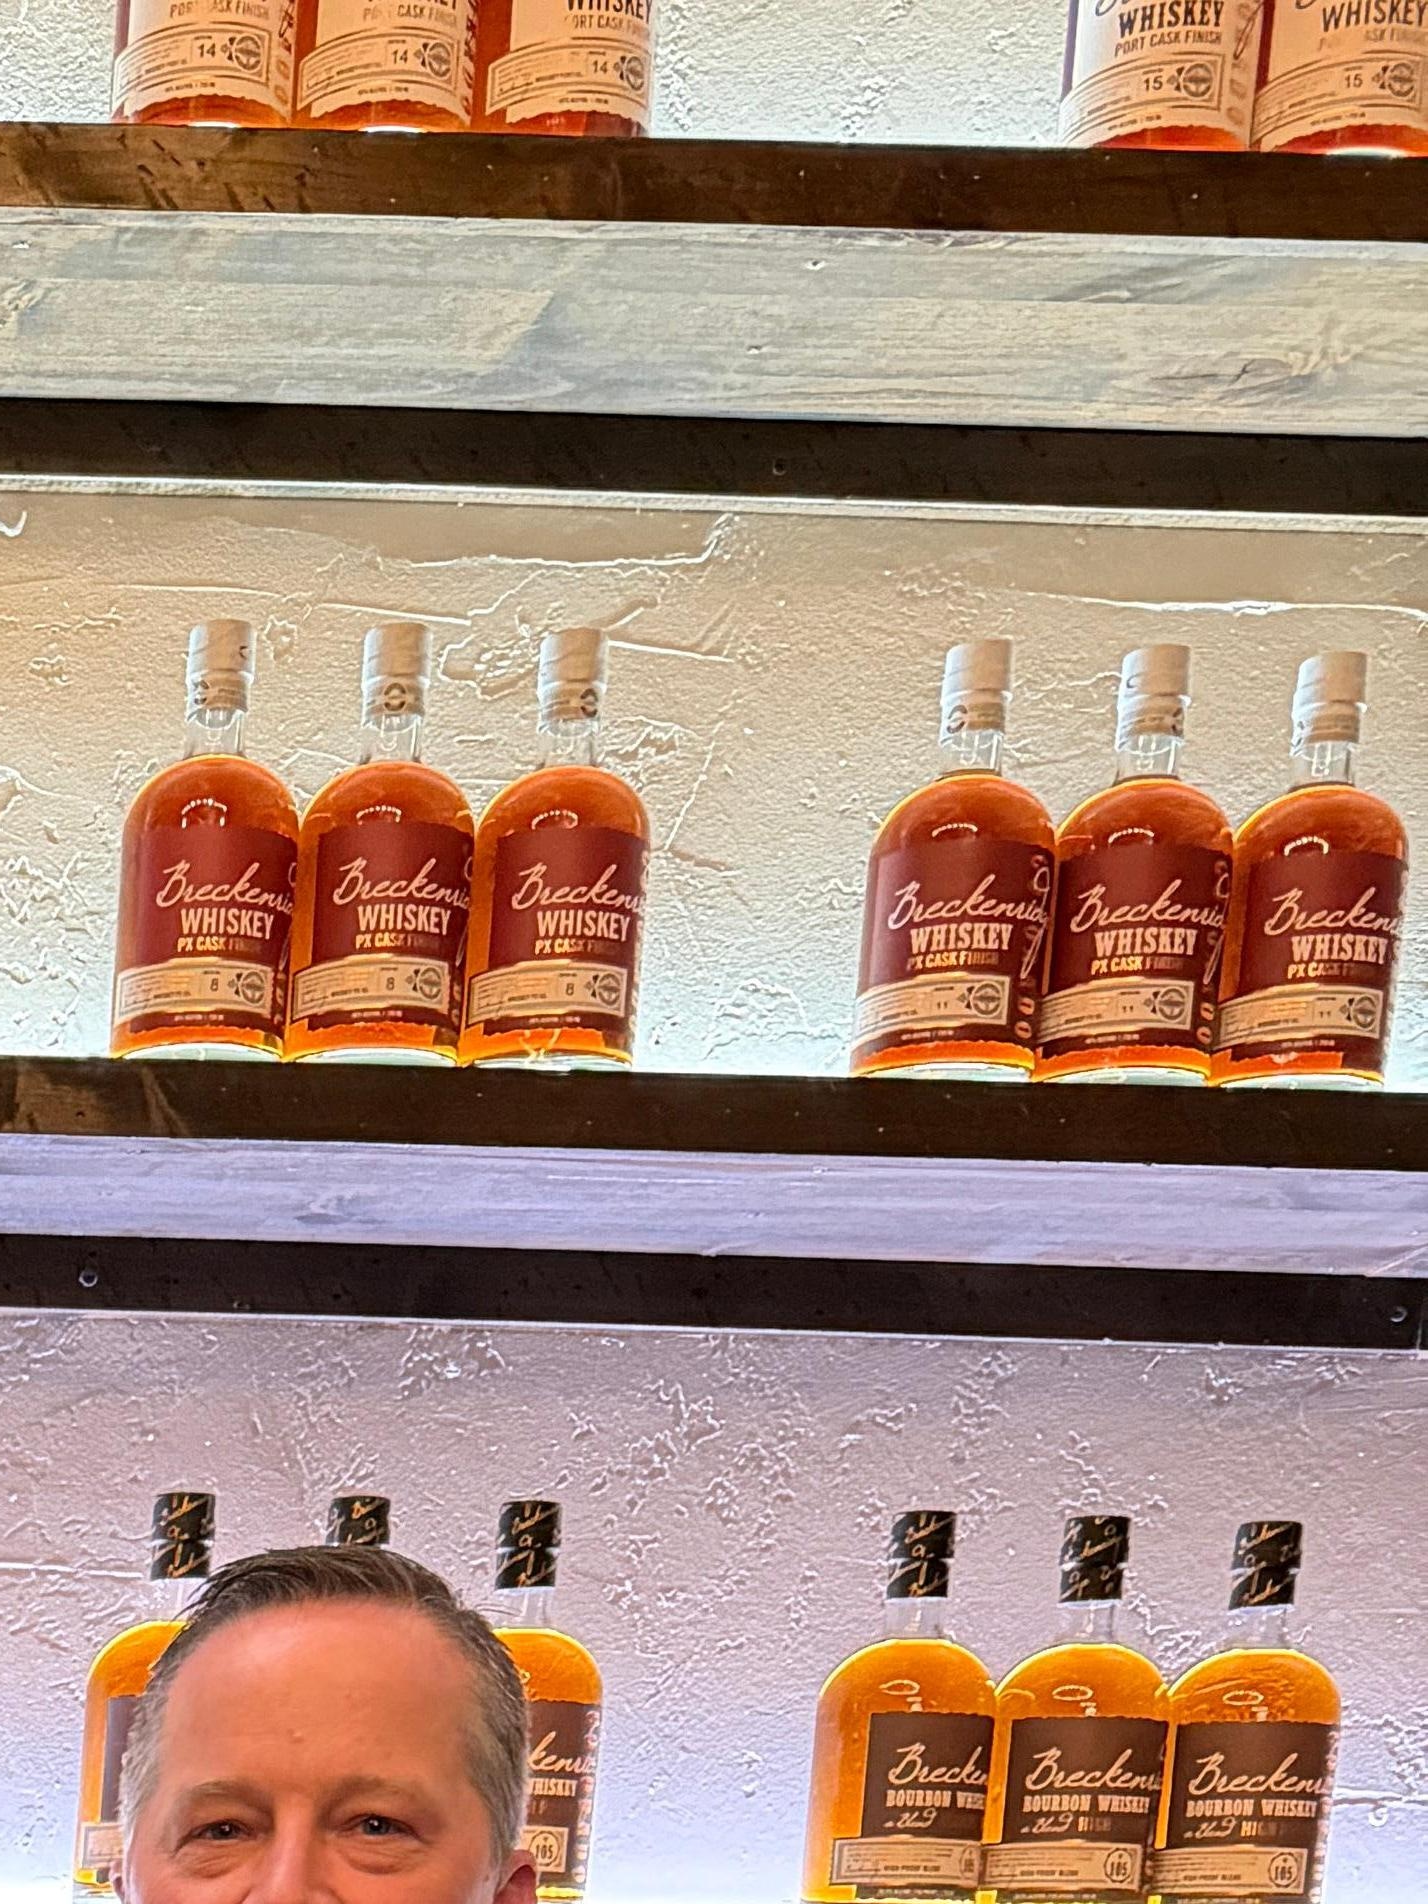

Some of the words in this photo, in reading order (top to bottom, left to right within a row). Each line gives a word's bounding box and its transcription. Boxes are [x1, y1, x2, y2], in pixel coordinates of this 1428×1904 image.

[1118, 1, 1224, 38] WHISKEY
[197, 42, 216, 59] 14
[1115, 34, 1145, 57] PORT
[1149, 30, 1181, 48] CASK
[1184, 29, 1222, 45] FINISH
[392, 49, 408, 64] 14
[592, 59, 608, 75] 14
[1143, 76, 1163, 91] 15
[180, 907, 274, 940] WHISKEY
[357, 904, 451, 936] WHISKEY
[538, 909, 630, 941] WHISKEY
[196, 936, 226, 951] CASK
[375, 932, 405, 948] CASK
[910, 922, 1013, 954] WHISKEY
[1095, 926, 1198, 958] WHISKEY
[535, 940, 552, 955] PX
[1291, 933, 1388, 965] WHISKEY
[925, 951, 957, 967] CASK
[1091, 959, 1108, 975] PX
[1111, 956, 1143, 972] CASK
[1288, 963, 1305, 979] PX
[886, 1789, 952, 1808] BOURBON
[1023, 1794, 1091, 1813] BOURBON
[1098, 1795, 1150, 1813] WHISKEY
[1186, 1800, 1254, 1818] BOURBON
[1261, 1801, 1318, 1818] WHISKEY
[1110, 1862, 1128, 1877] 105
[1275, 1865, 1293, 1881] 105
